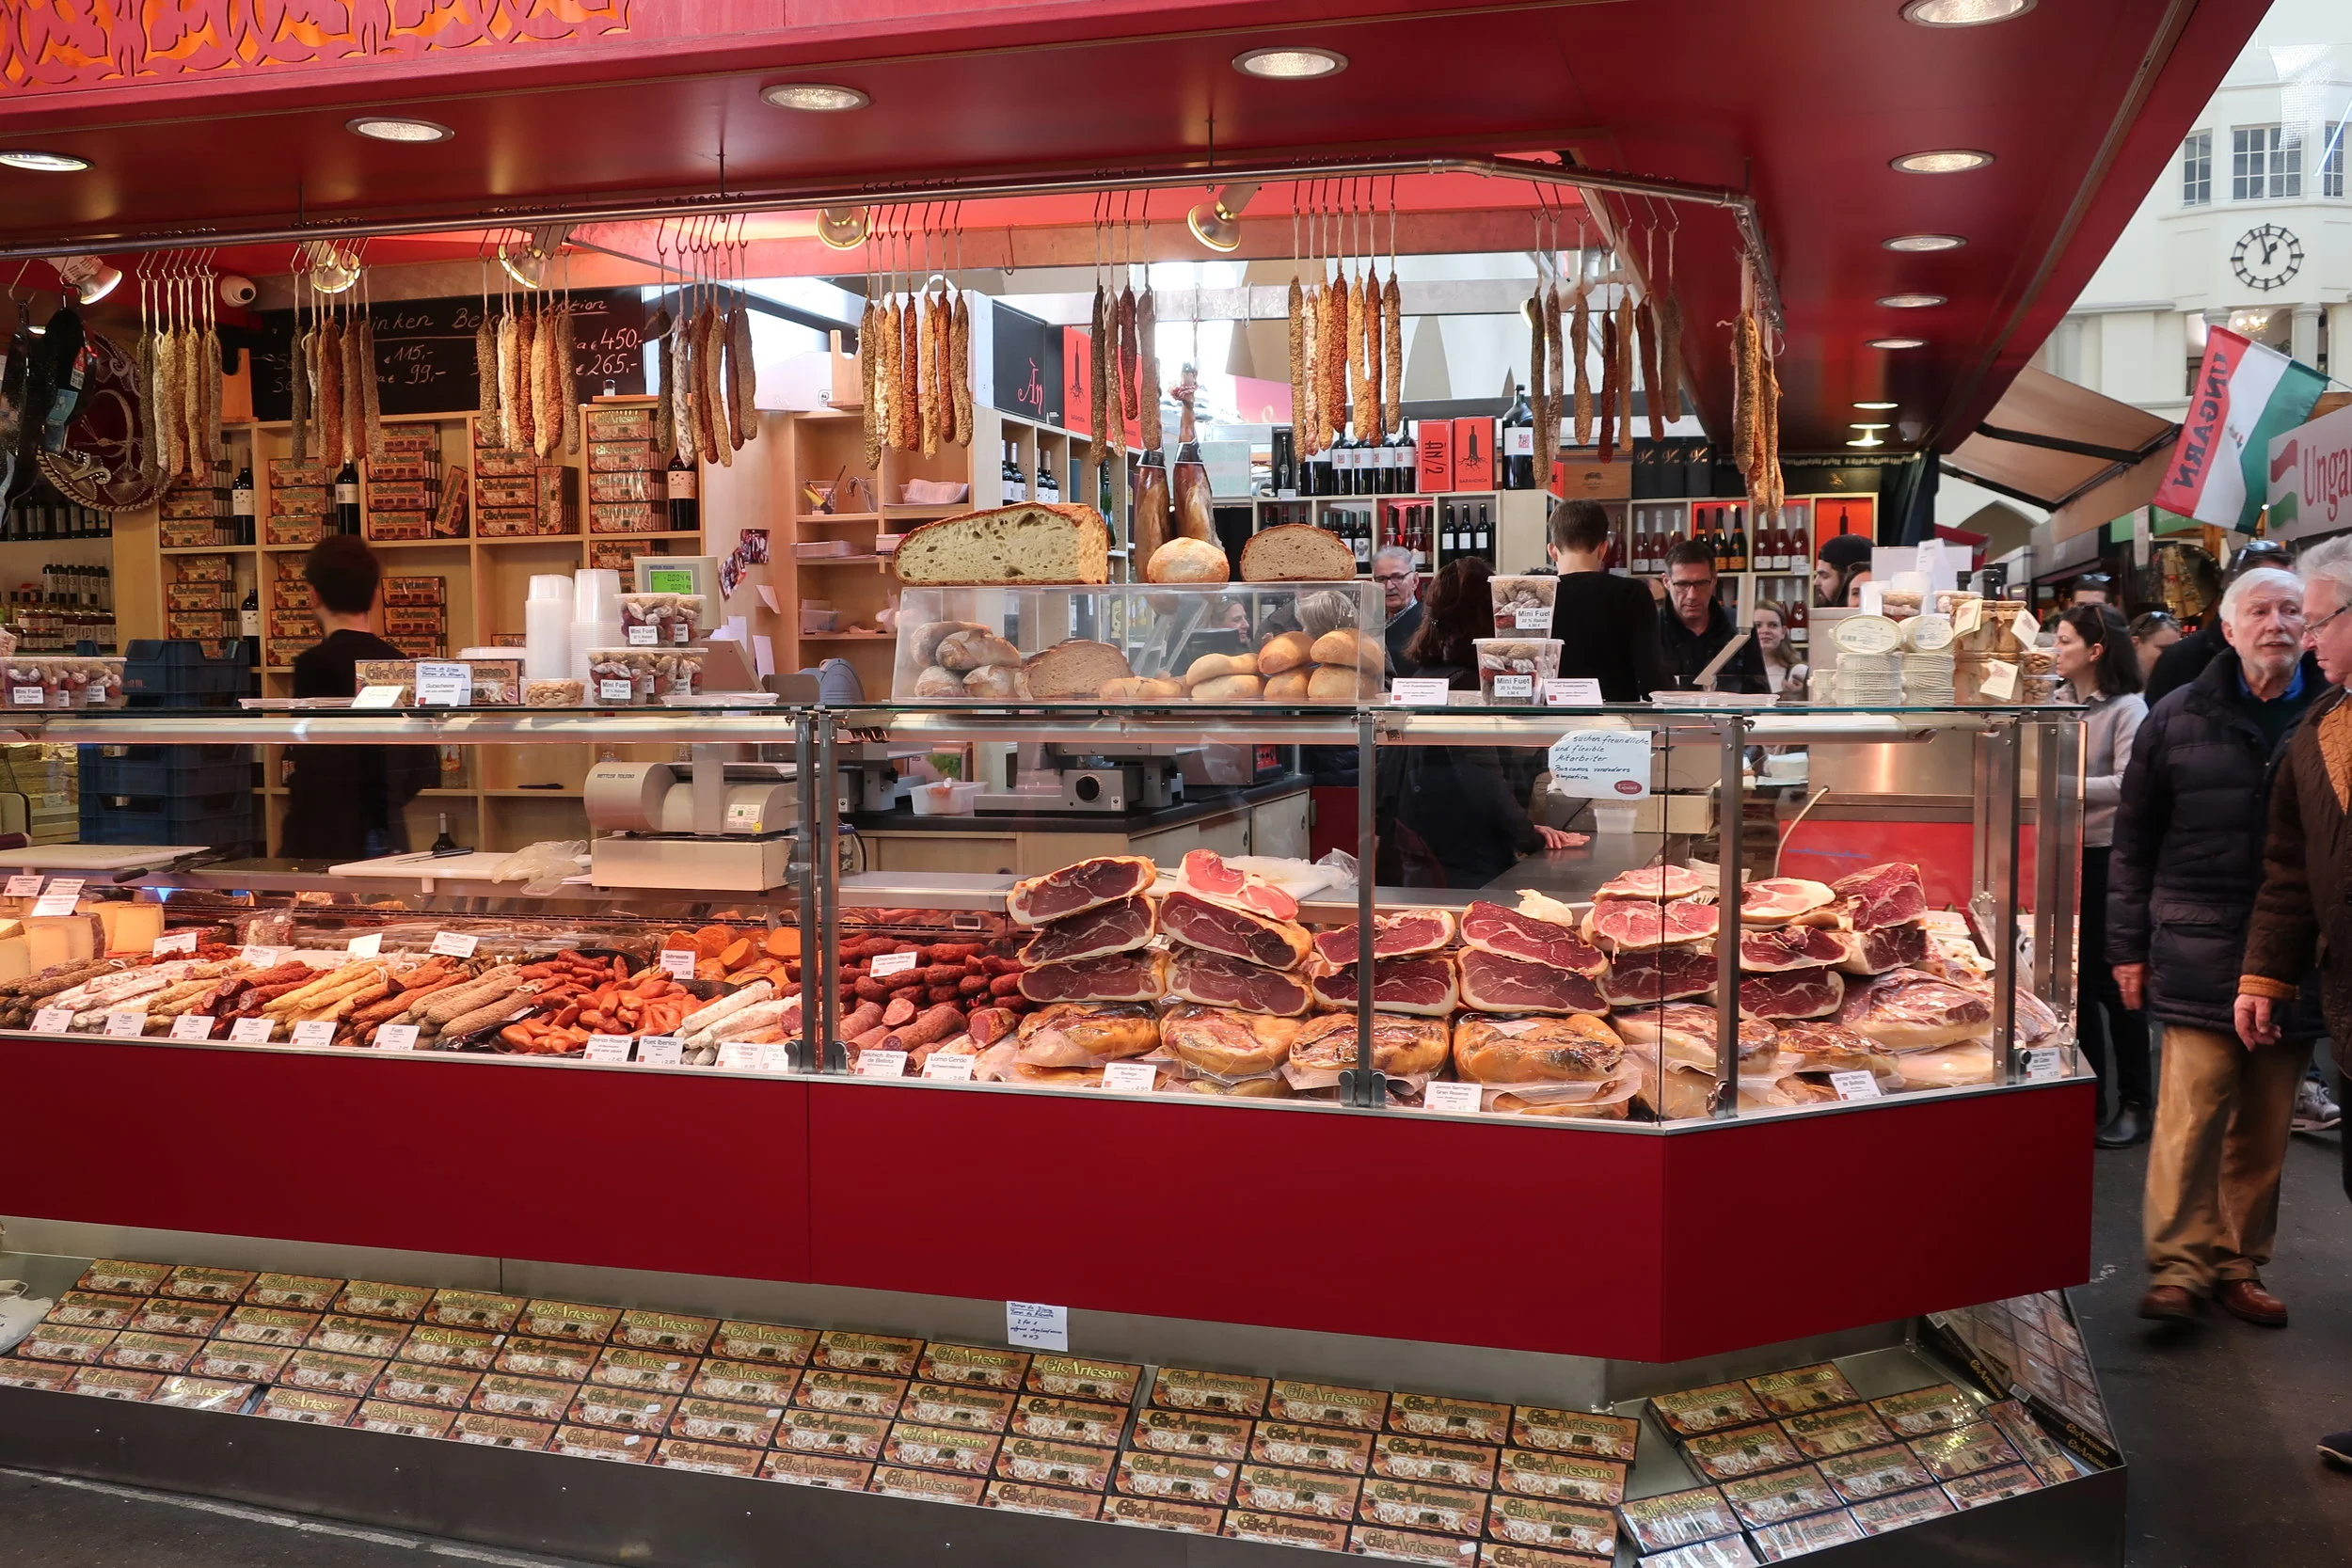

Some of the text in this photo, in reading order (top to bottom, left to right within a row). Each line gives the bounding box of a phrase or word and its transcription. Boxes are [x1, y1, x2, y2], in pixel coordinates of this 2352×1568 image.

[600, 328, 644, 350] 450,-
[587, 354, 639, 376] 265,-
[405, 362, 447, 385] 99,-
[2303, 445, 2352, 523] Unga
[1518, 610, 1550, 618] Mini Fuet
[1602, 736, 1649, 746] freundliche
[1571, 745, 1605, 754] flexible
[1555, 753, 1609, 763] Mitarbeiter
